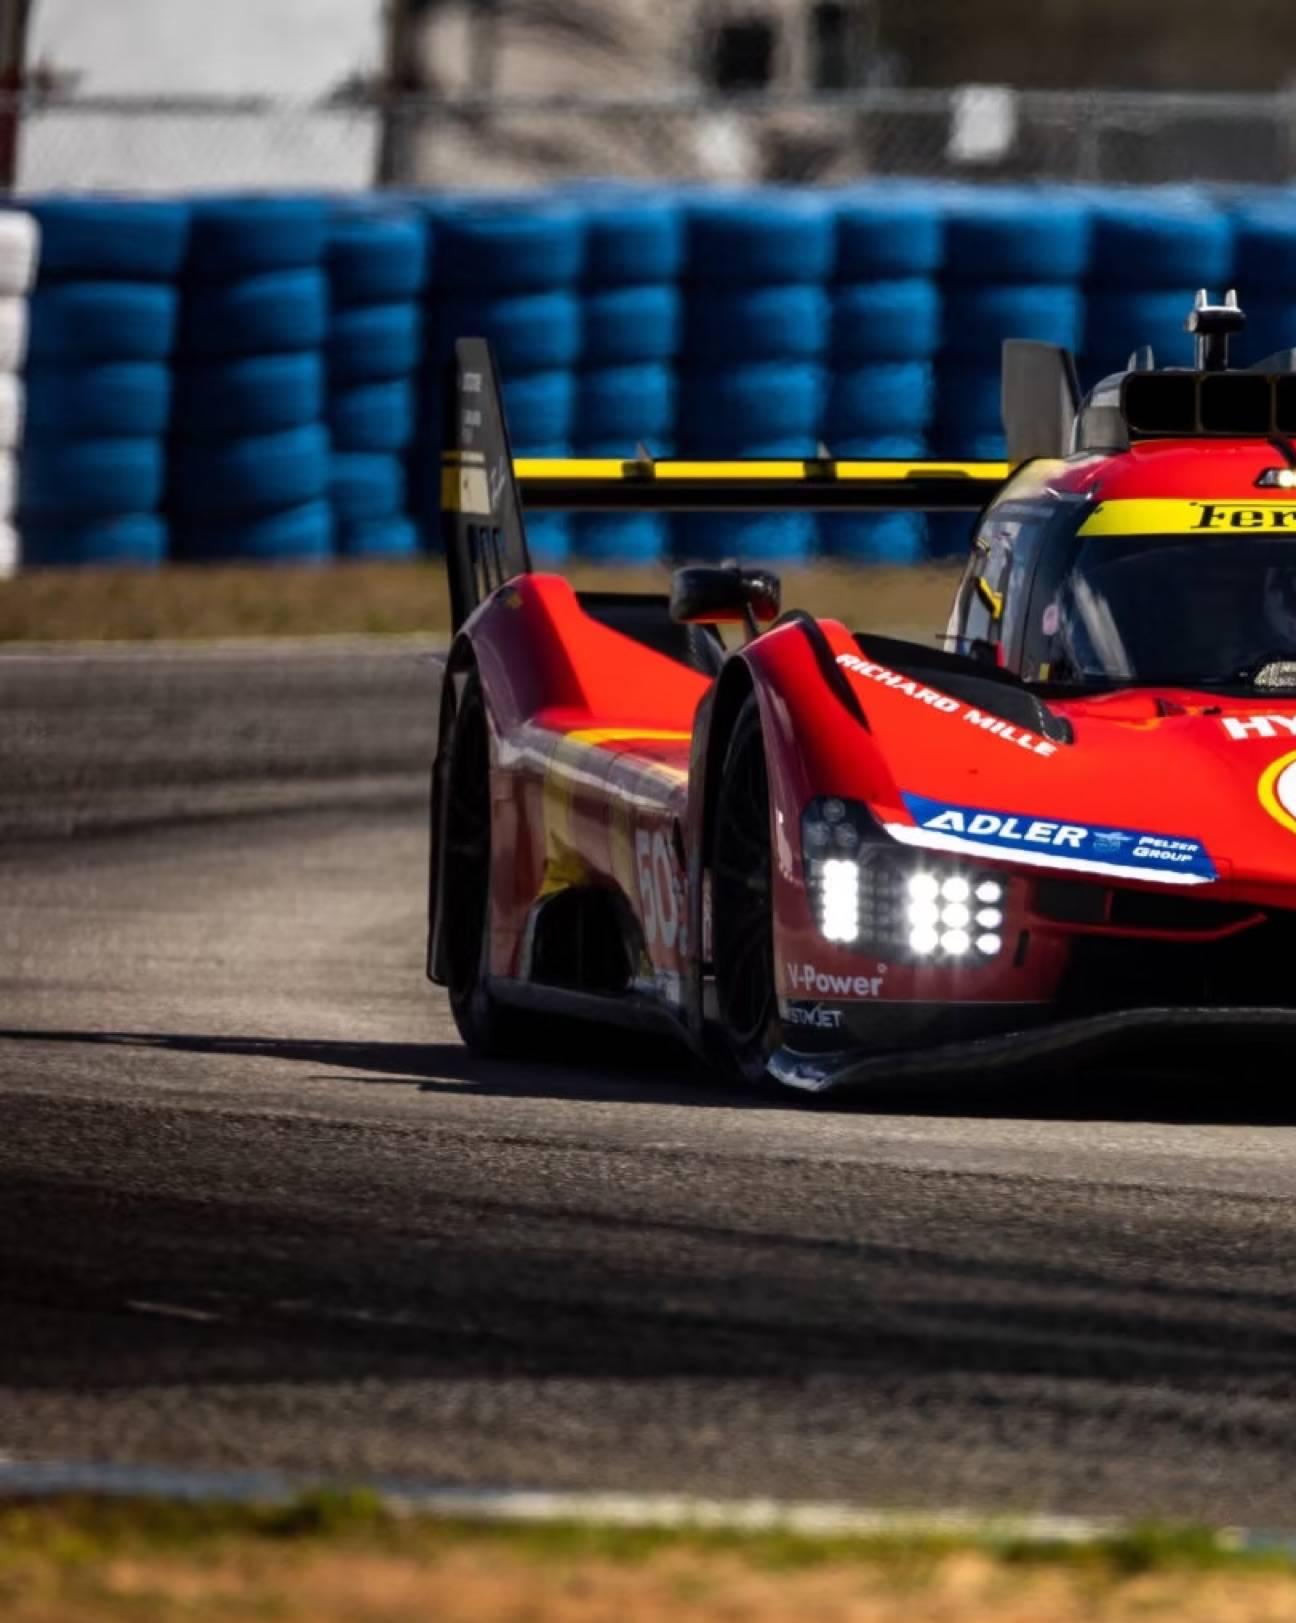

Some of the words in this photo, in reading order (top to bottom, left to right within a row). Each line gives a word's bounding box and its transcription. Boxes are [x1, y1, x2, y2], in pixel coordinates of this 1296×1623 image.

[835, 653, 961, 713] RICHARD
[963, 708, 1057, 757] MILLE
[923, 810, 1089, 848] ADLER
[1132, 846, 1193, 863] GROUP
[636, 829, 680, 947] 50
[787, 962, 883, 997] V-Power
